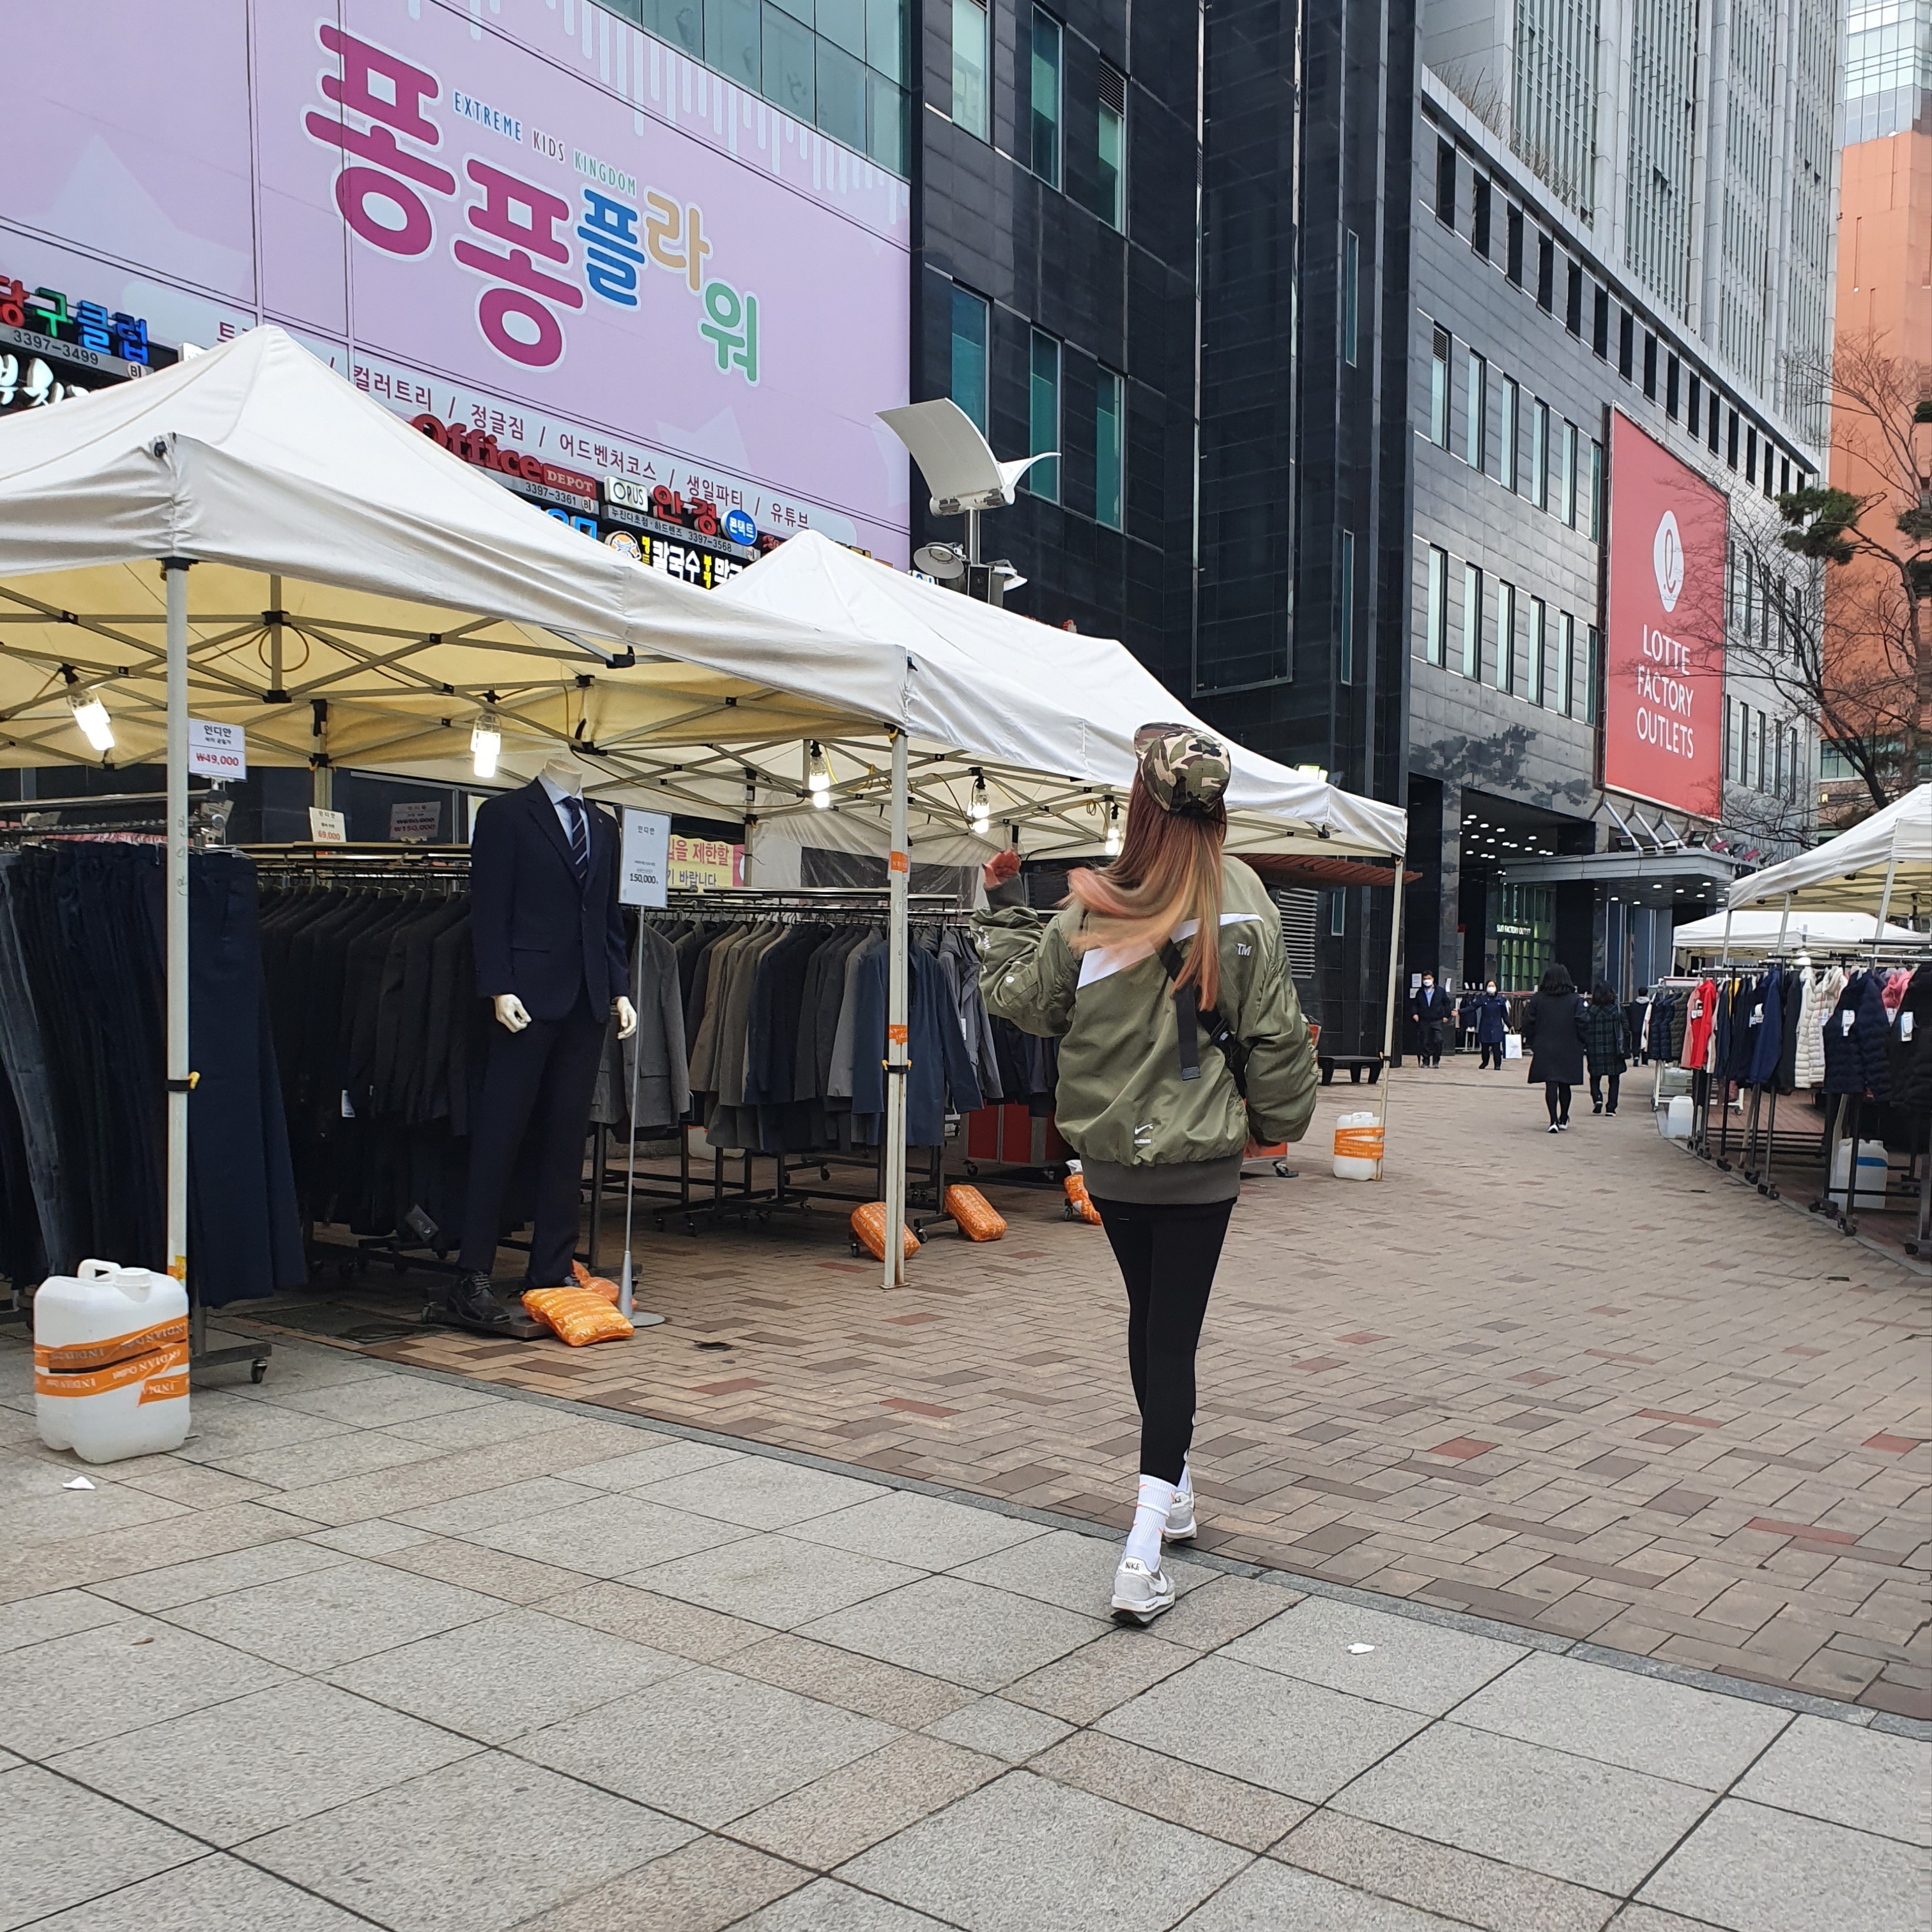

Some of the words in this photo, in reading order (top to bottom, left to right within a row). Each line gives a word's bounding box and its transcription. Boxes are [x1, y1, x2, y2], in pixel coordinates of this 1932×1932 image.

[454, 91, 521, 141] EXTREME
[533, 130, 564, 162] KIDS
[574, 151, 636, 196] KINGDOM
[0, 275, 149, 365] 당구클럽
[13, 329, 99, 365] 3397-3499
[354, 365, 432, 412] 컬러트리
[471, 404, 524, 441] 정글짐
[560, 433, 657, 481] 어드벤처코스
[686, 474, 743, 510] 생일파티
[770, 503, 810, 530] 유튜브
[409, 413, 544, 484] Office
[525, 482, 576, 506] 3397-3361
[546, 469, 594, 493] DEPOT
[613, 482, 644, 506] OPUS
[650, 484, 717, 535] 안경
[652, 540, 701, 583] 칼국수
[688, 531, 732, 553] 3397-3568
[1643, 624, 1690, 676] LOTTE
[1637, 663, 1694, 717] FACTORY
[203, 724, 232, 738] 인디안
[1636, 707, 1694, 759] OUTLETS
[693, 842, 730, 867] 제한할
[679, 870, 717, 887] 바랍니다
[1238, 942, 1252, 956] TM
